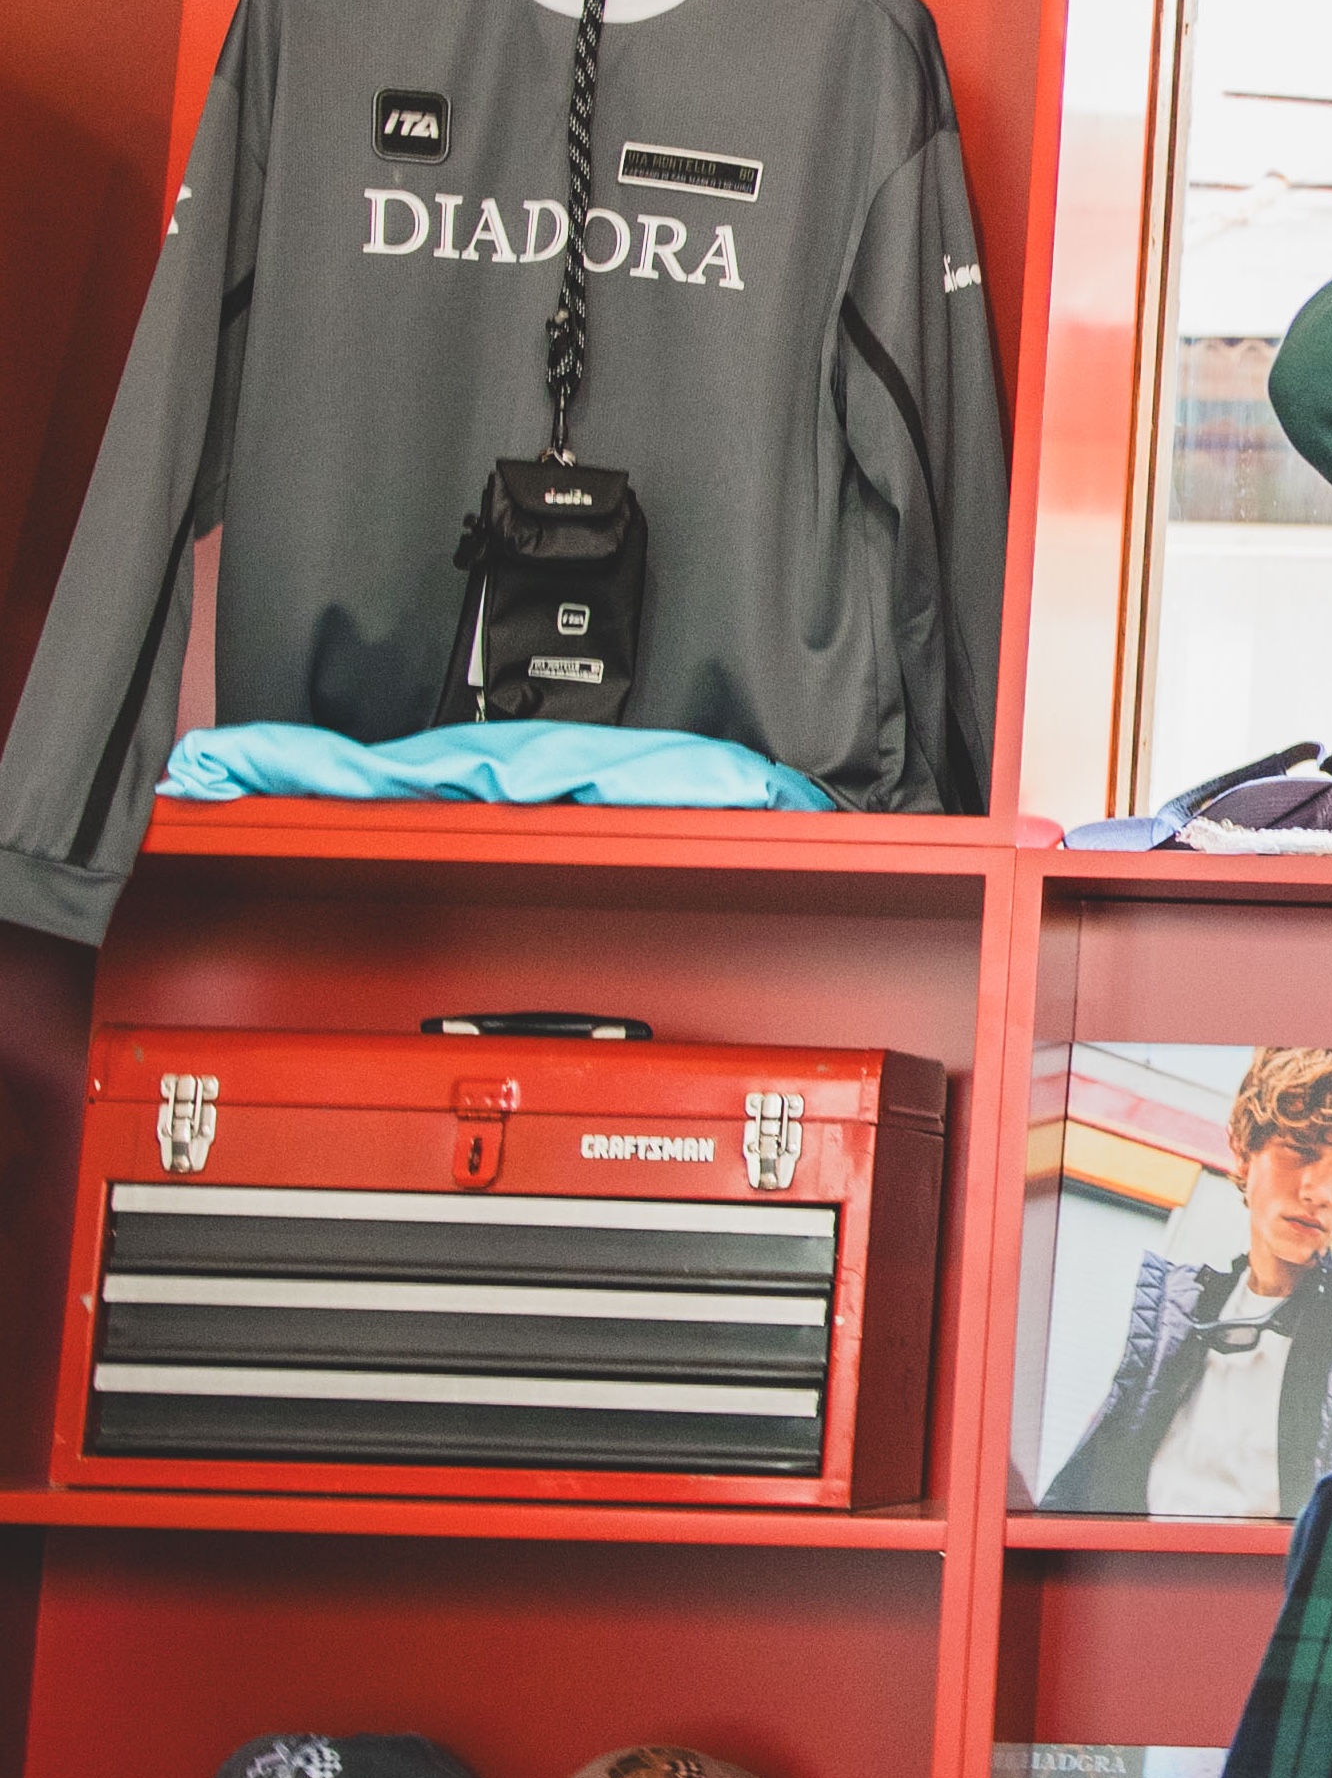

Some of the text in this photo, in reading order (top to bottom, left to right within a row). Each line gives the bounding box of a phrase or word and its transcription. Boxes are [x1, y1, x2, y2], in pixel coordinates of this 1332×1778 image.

[384, 109, 440, 140] ITA
[362, 188, 745, 291] DIADORA
[581, 1133, 716, 1163] CRAFTSMAN
